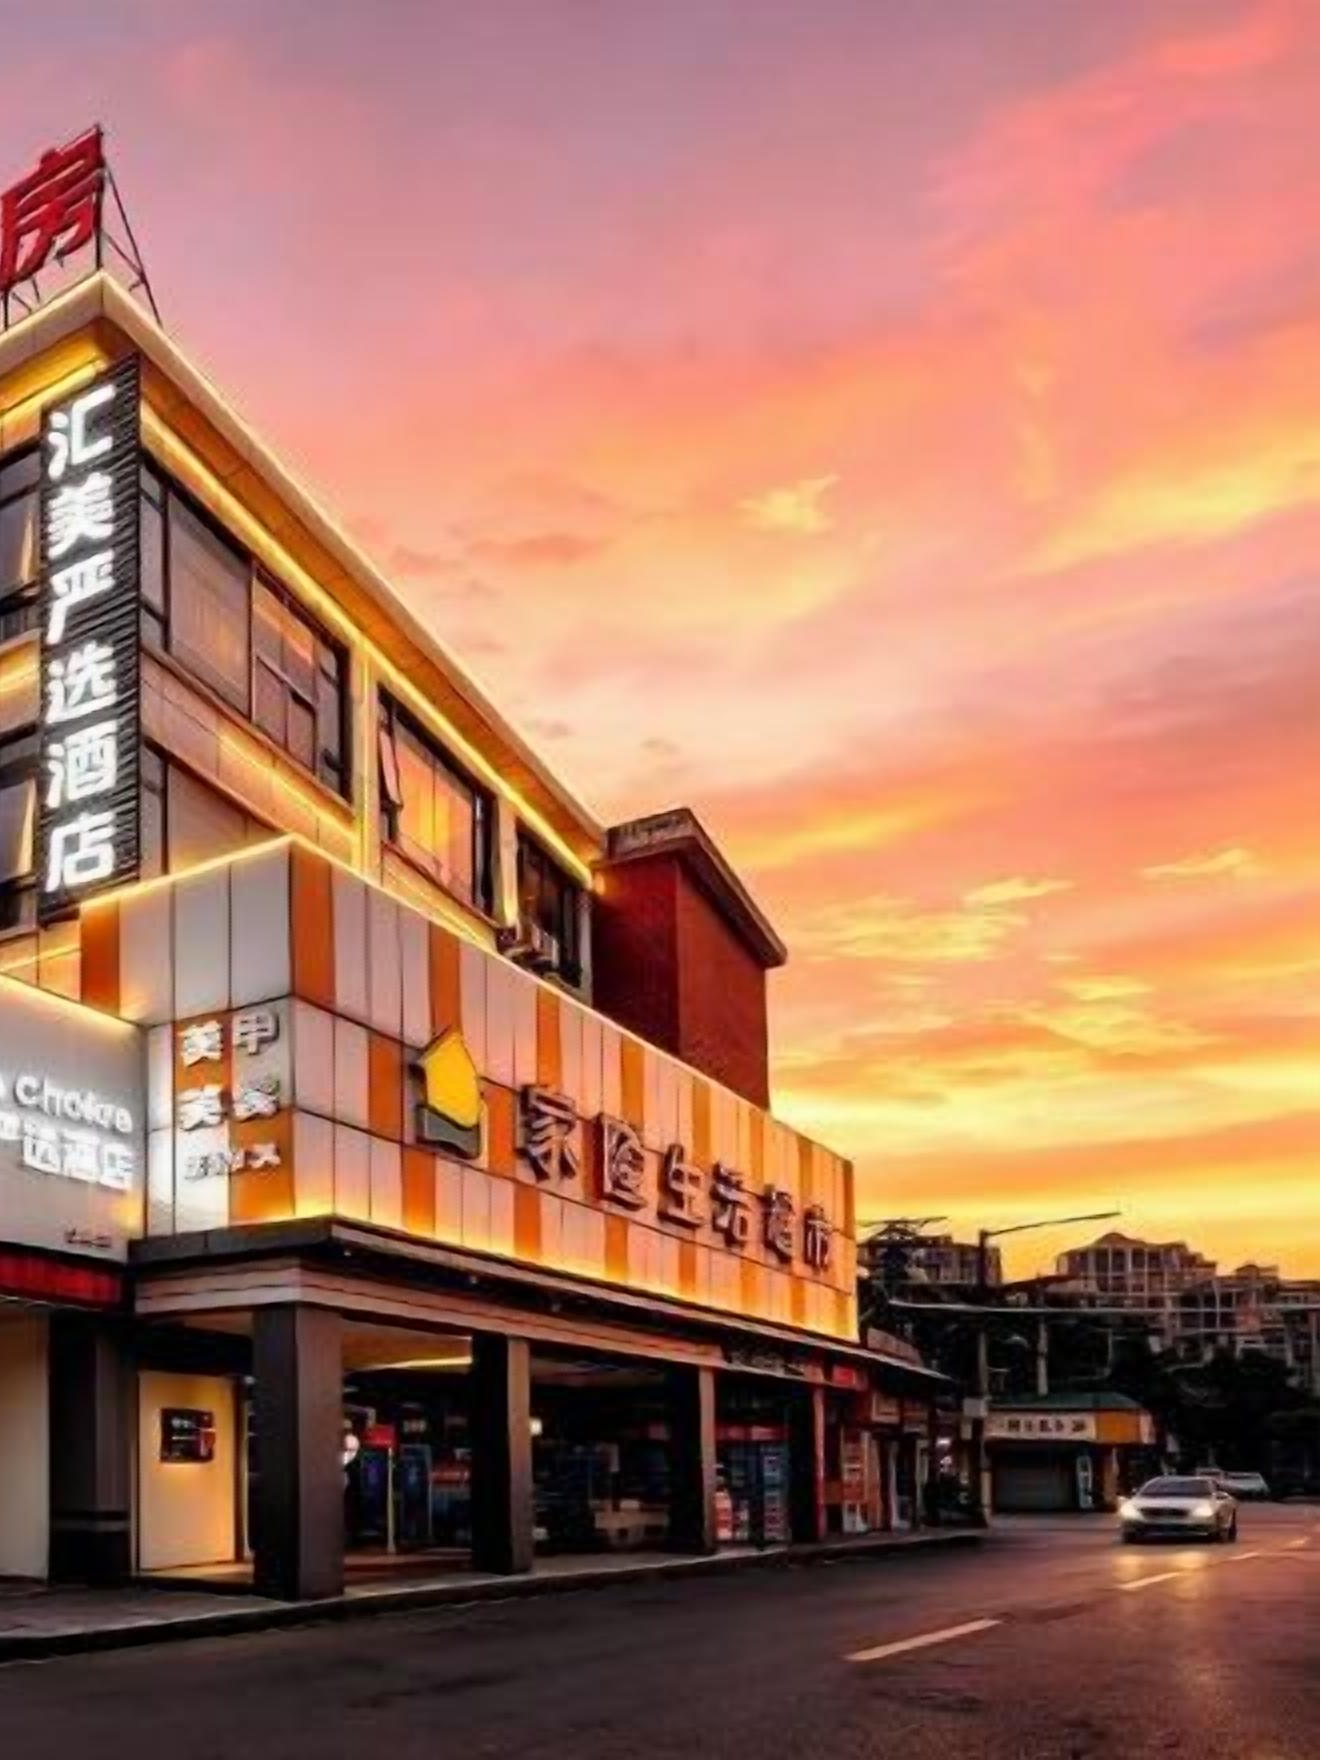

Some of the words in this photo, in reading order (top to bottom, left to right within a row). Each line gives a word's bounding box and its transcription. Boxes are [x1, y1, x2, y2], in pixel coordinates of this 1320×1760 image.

[45, 383, 118, 894] 汇美严选酒店
